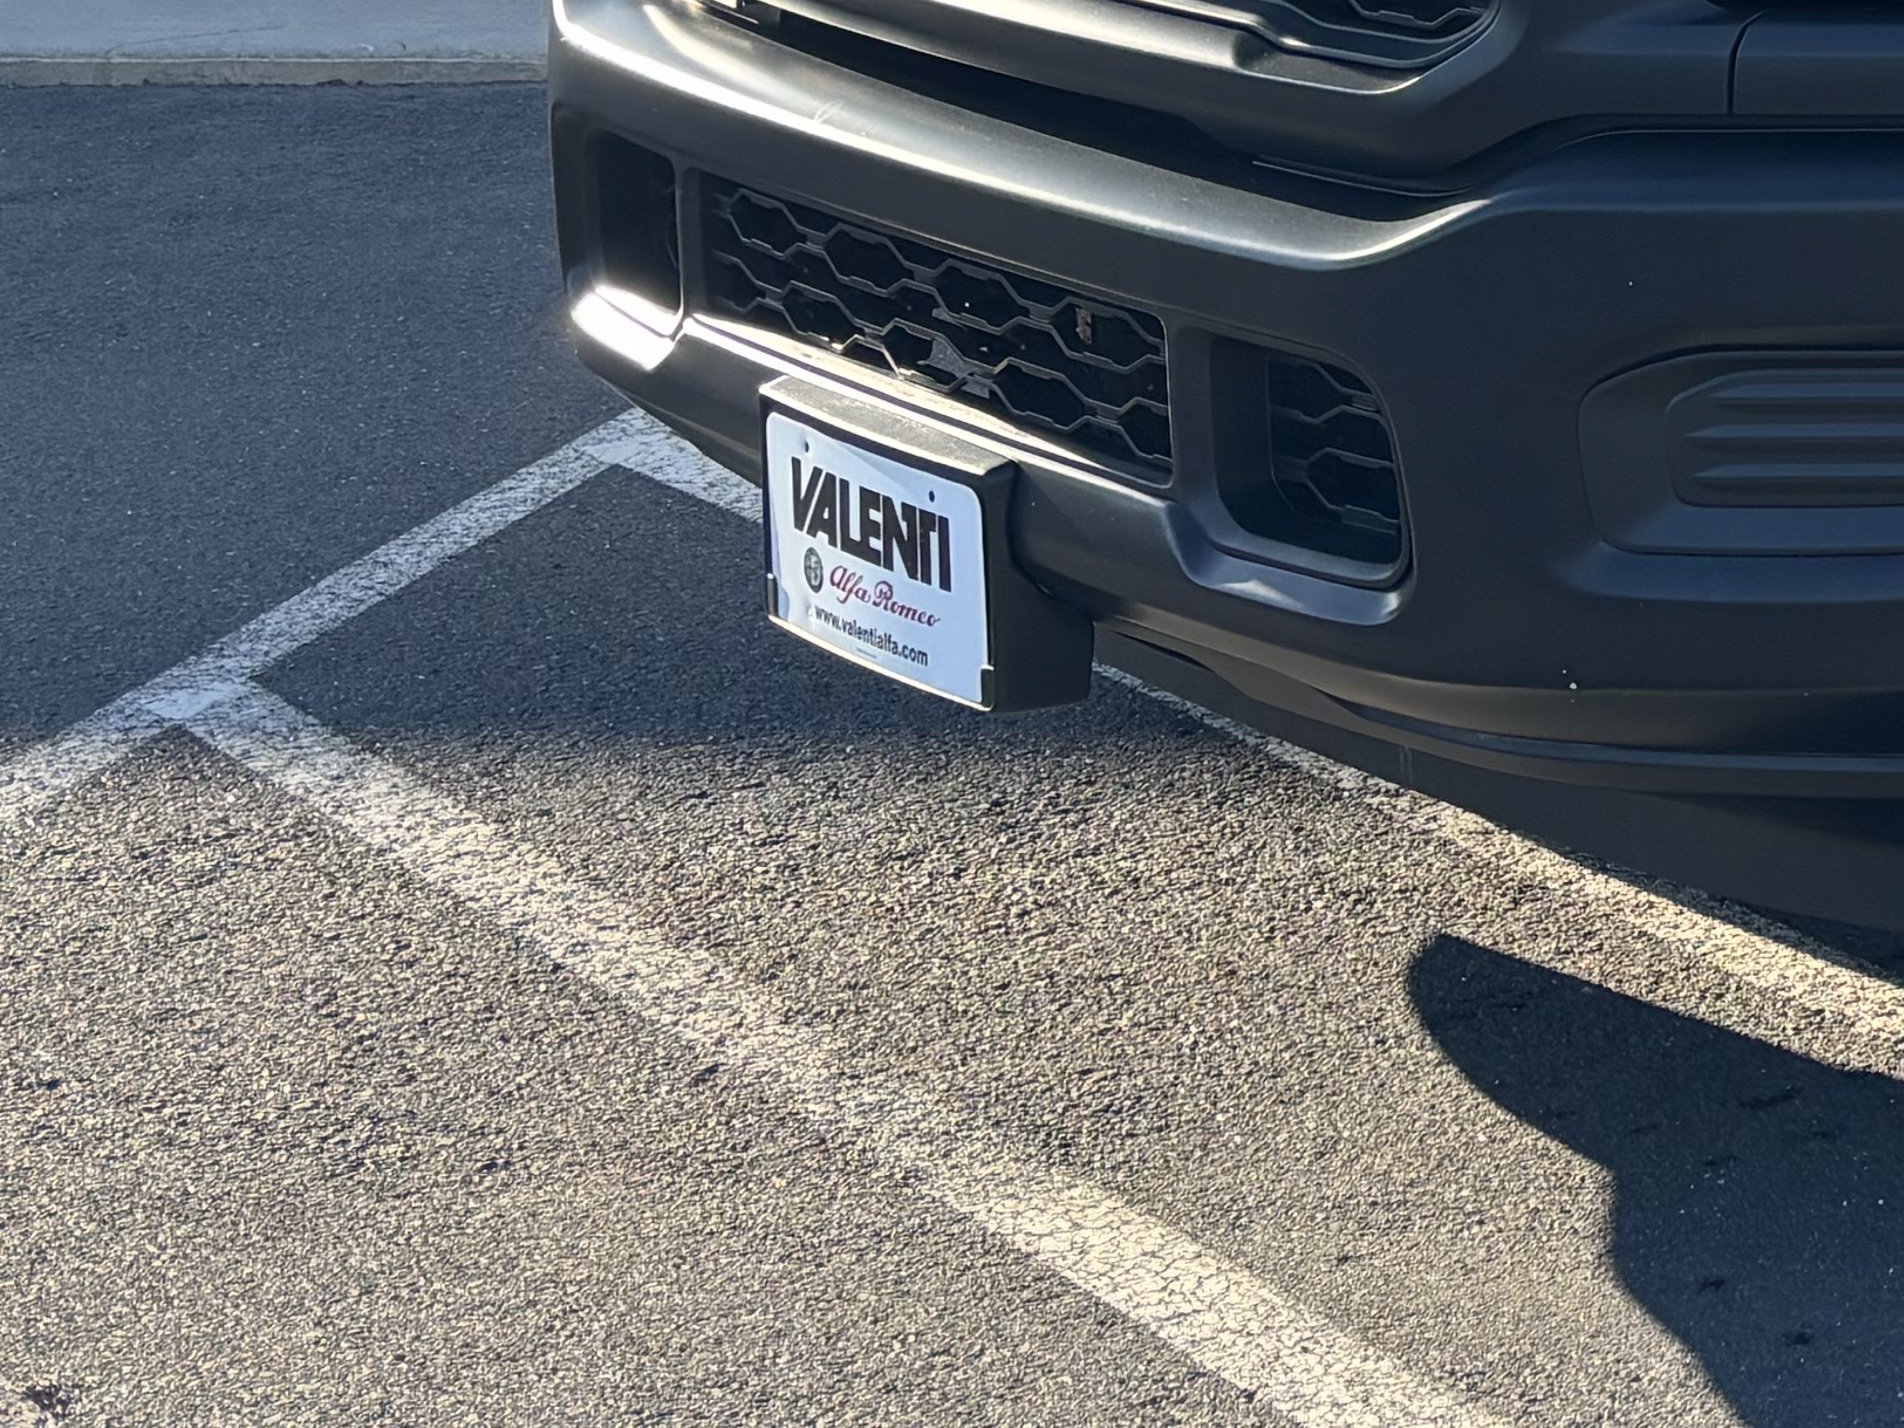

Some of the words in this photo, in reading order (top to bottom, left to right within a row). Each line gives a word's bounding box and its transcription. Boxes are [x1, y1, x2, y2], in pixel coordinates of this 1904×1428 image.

[790, 455, 952, 593] VALENTI
[829, 565, 872, 605] Alfa
[871, 580, 940, 627] Romeo
[813, 604, 929, 667] www.valentialfa.com
